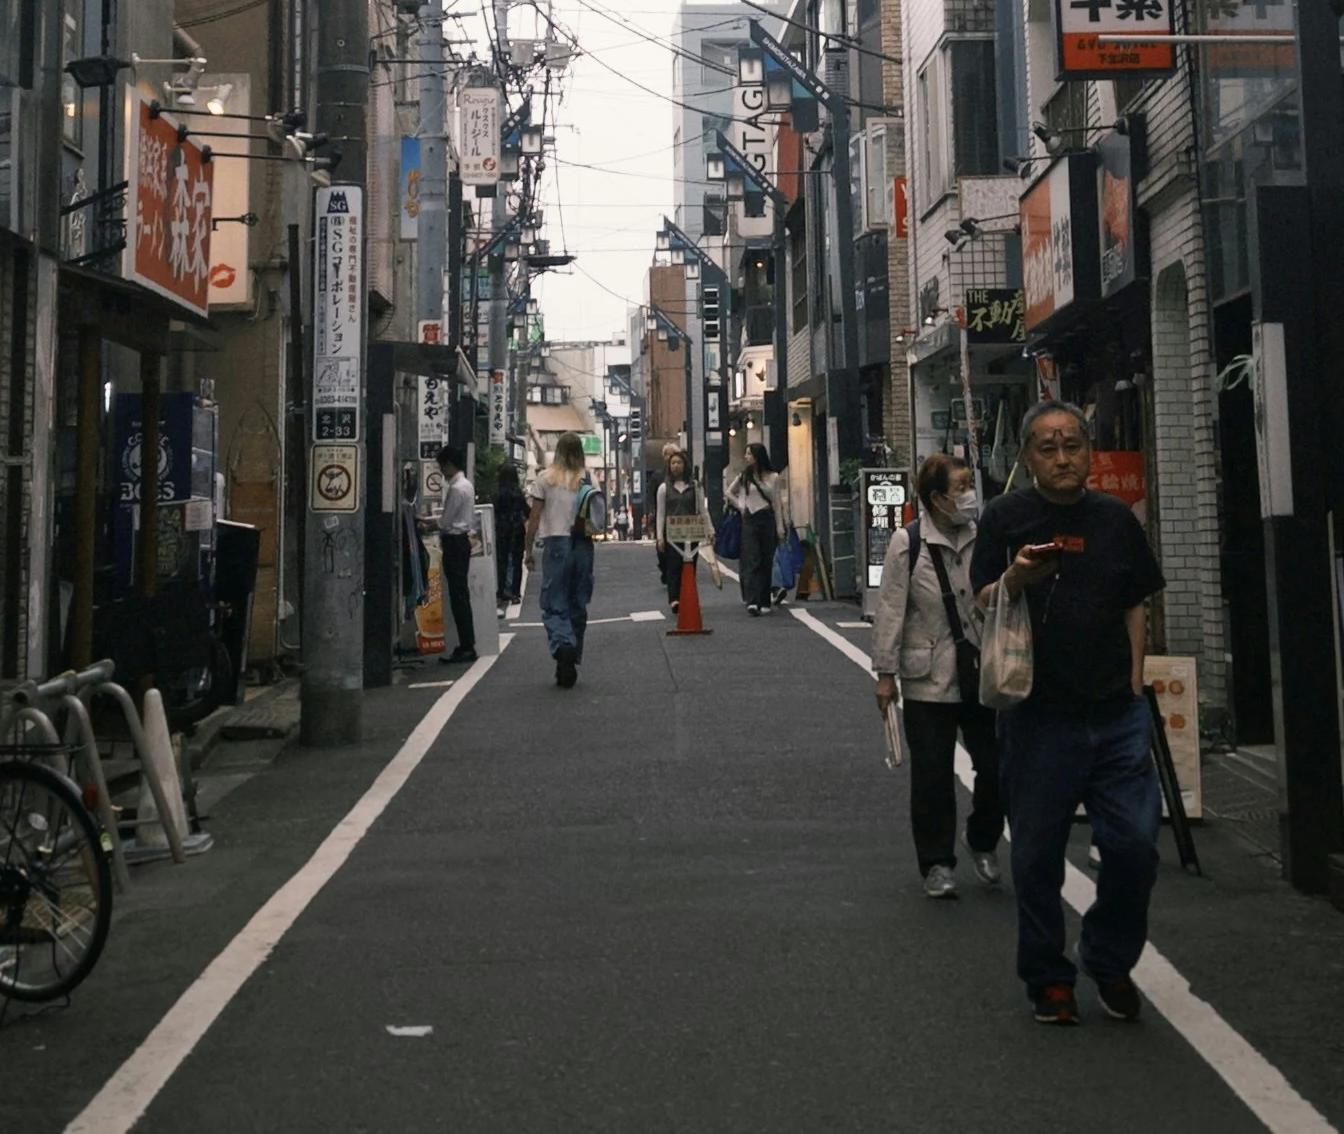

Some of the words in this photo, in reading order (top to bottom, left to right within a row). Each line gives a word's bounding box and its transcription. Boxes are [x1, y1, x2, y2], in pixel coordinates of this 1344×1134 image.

[329, 200, 346, 211] SG
[968, 290, 989, 303] THE
[321, 426, 351, 437] 2-33
